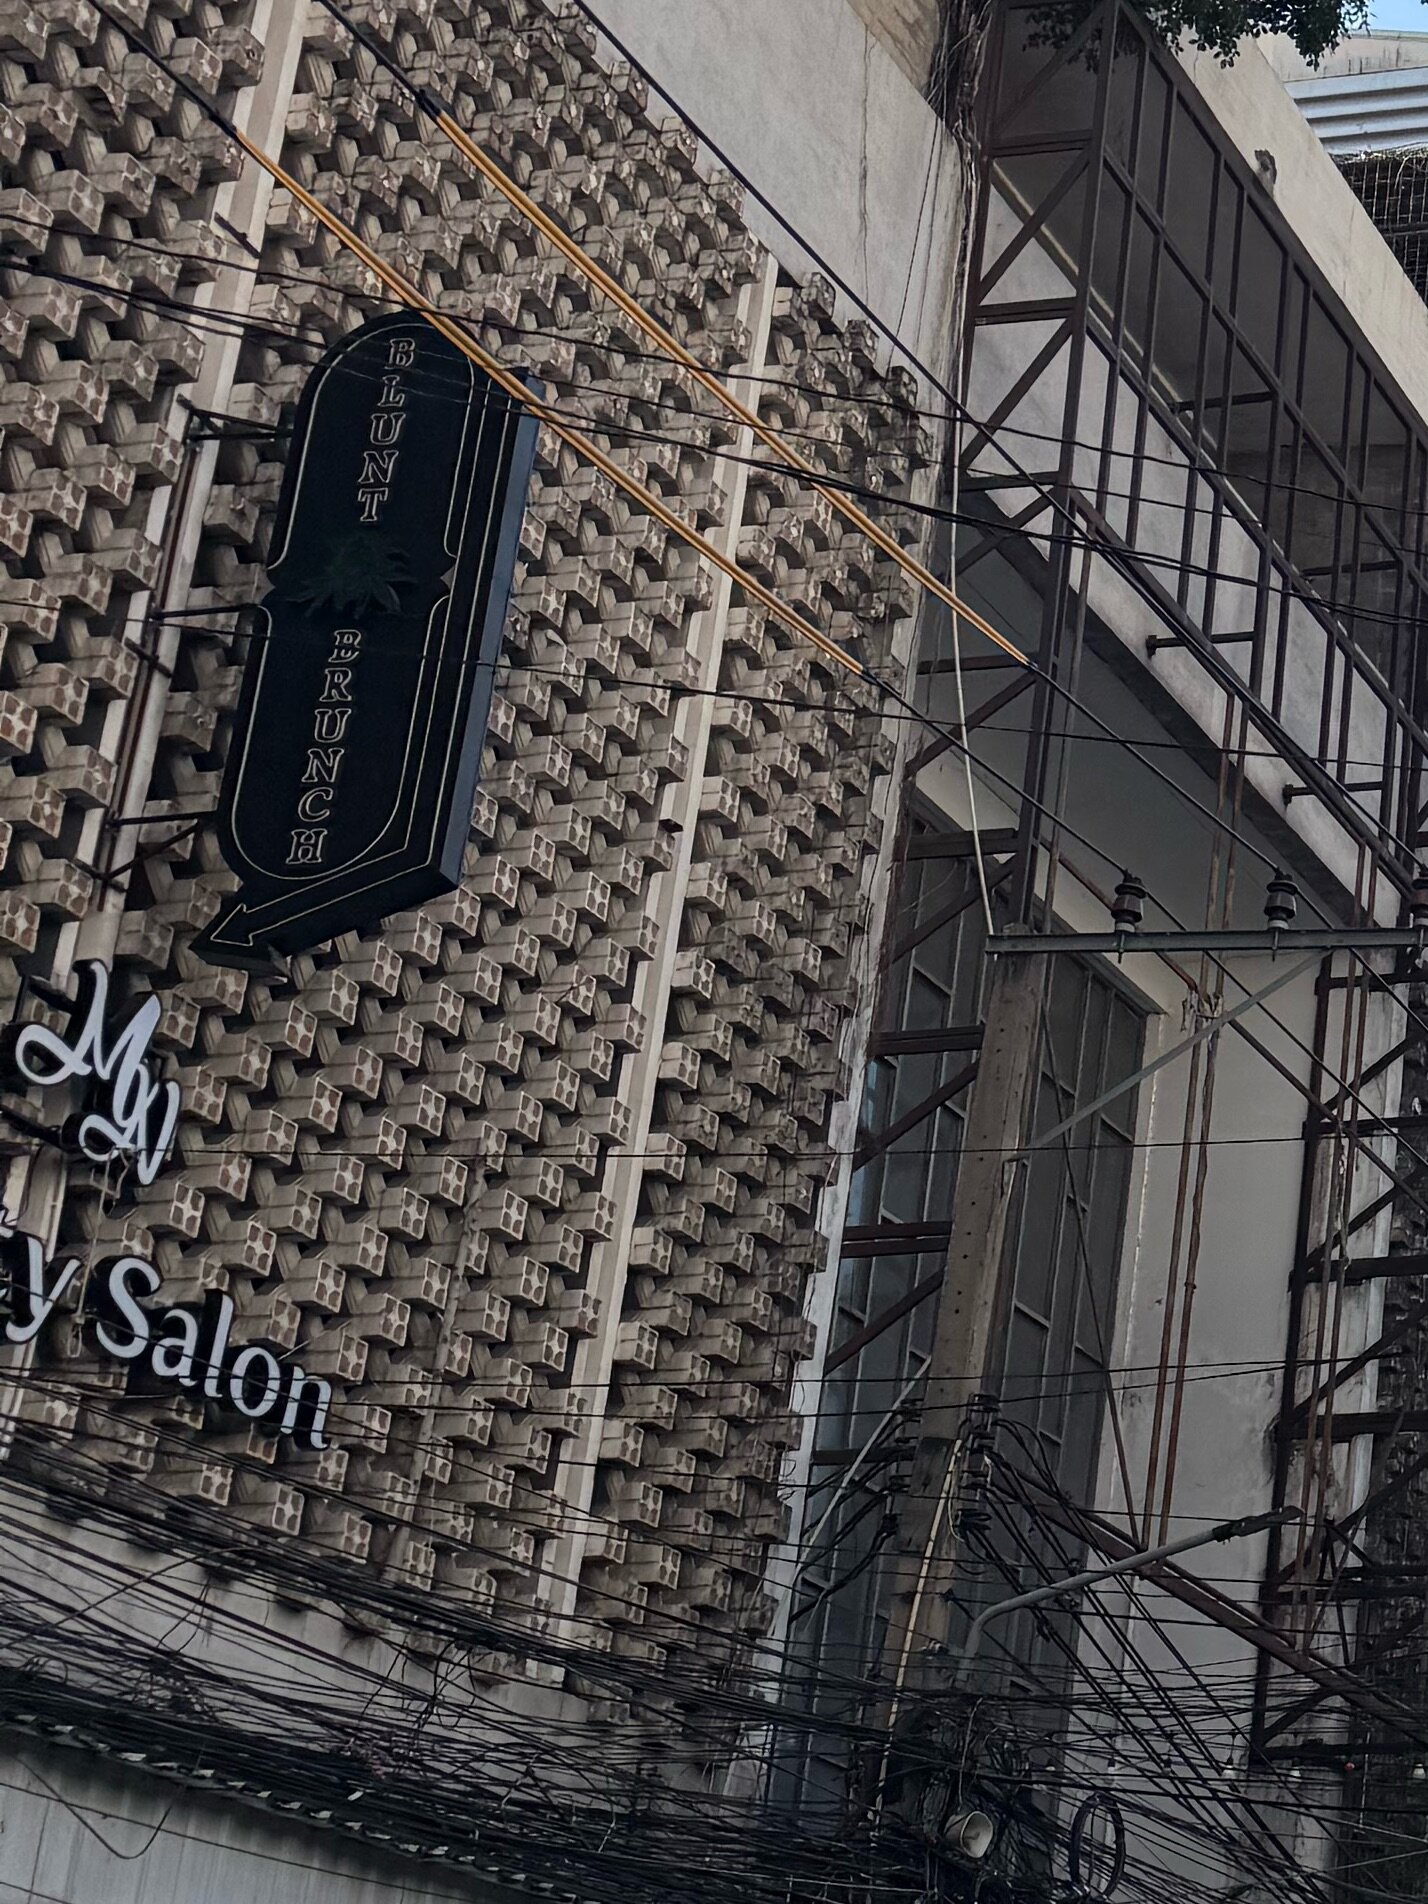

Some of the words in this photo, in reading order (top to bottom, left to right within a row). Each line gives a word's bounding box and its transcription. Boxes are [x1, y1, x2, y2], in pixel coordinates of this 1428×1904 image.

[357, 337, 416, 524] BLUNT
[285, 628, 360, 865] BRUNCH
[0, 1236, 81, 1342] y
[96, 1257, 331, 1449] Salon
